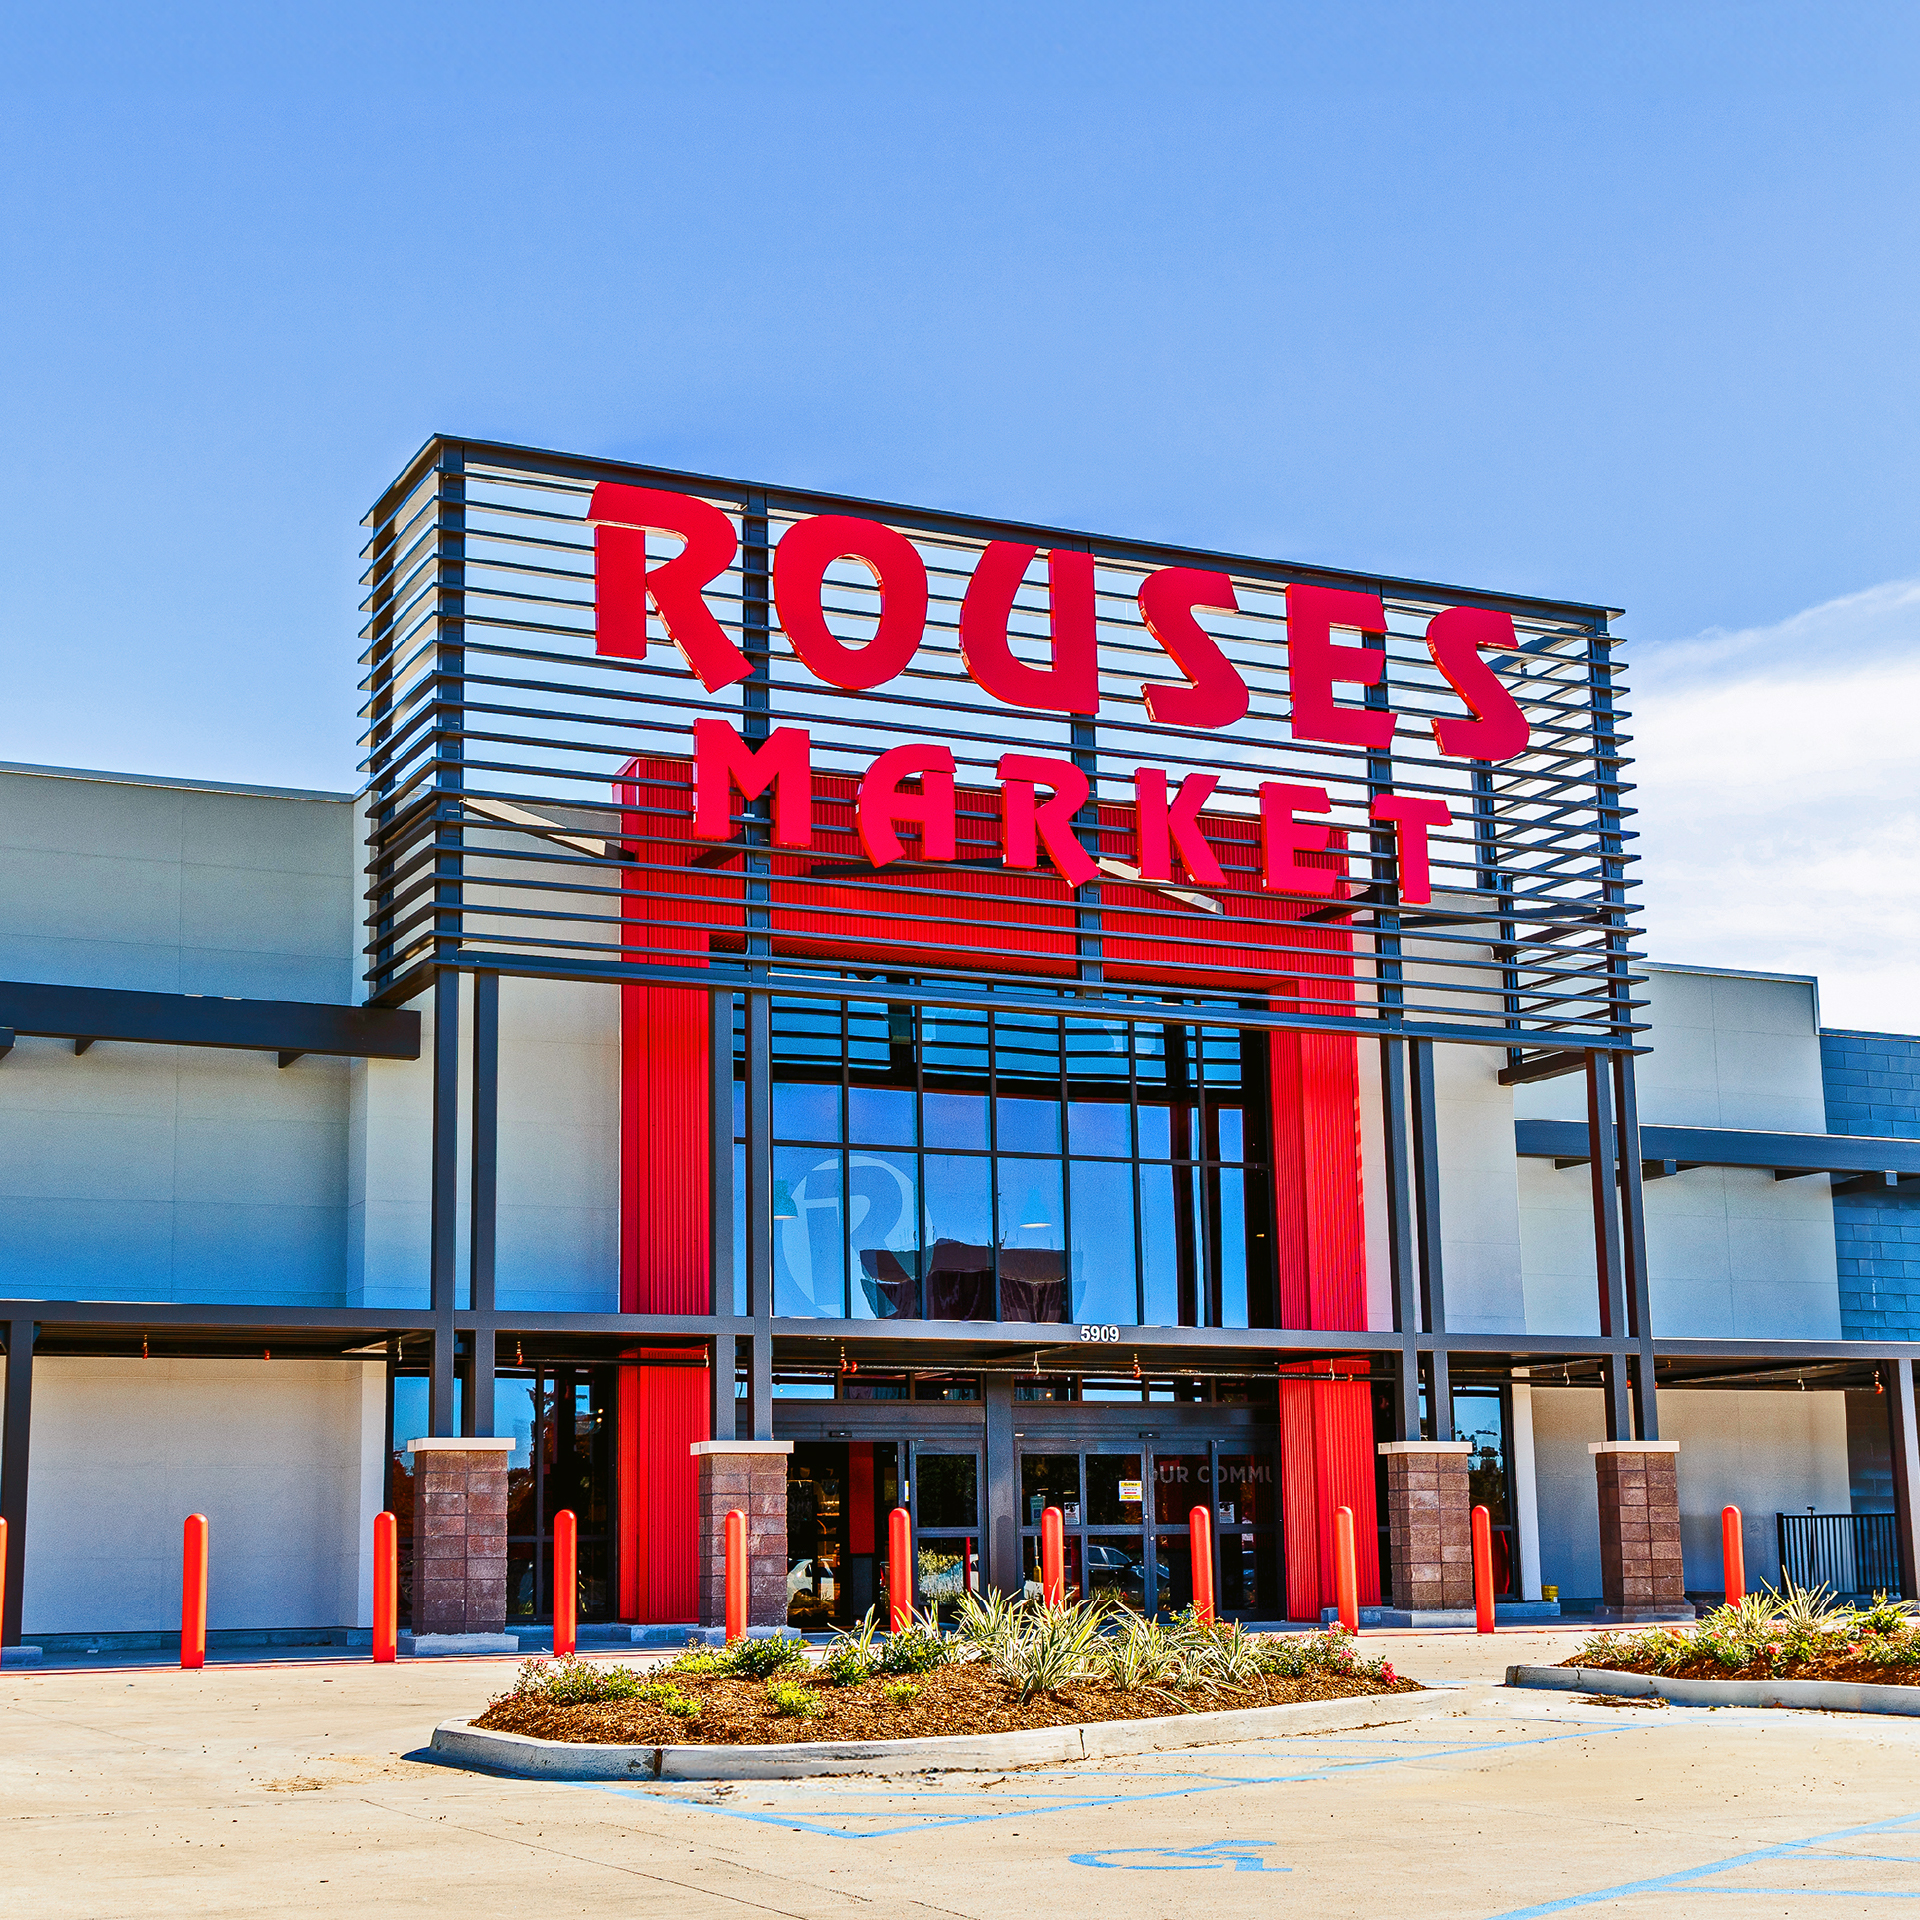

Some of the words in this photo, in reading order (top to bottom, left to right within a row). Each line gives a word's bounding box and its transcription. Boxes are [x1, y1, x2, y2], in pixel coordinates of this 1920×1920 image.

[586, 482, 1531, 761] ROUSES
[692, 717, 1452, 905] MARKET
[1080, 1324, 1119, 1343] 5909
